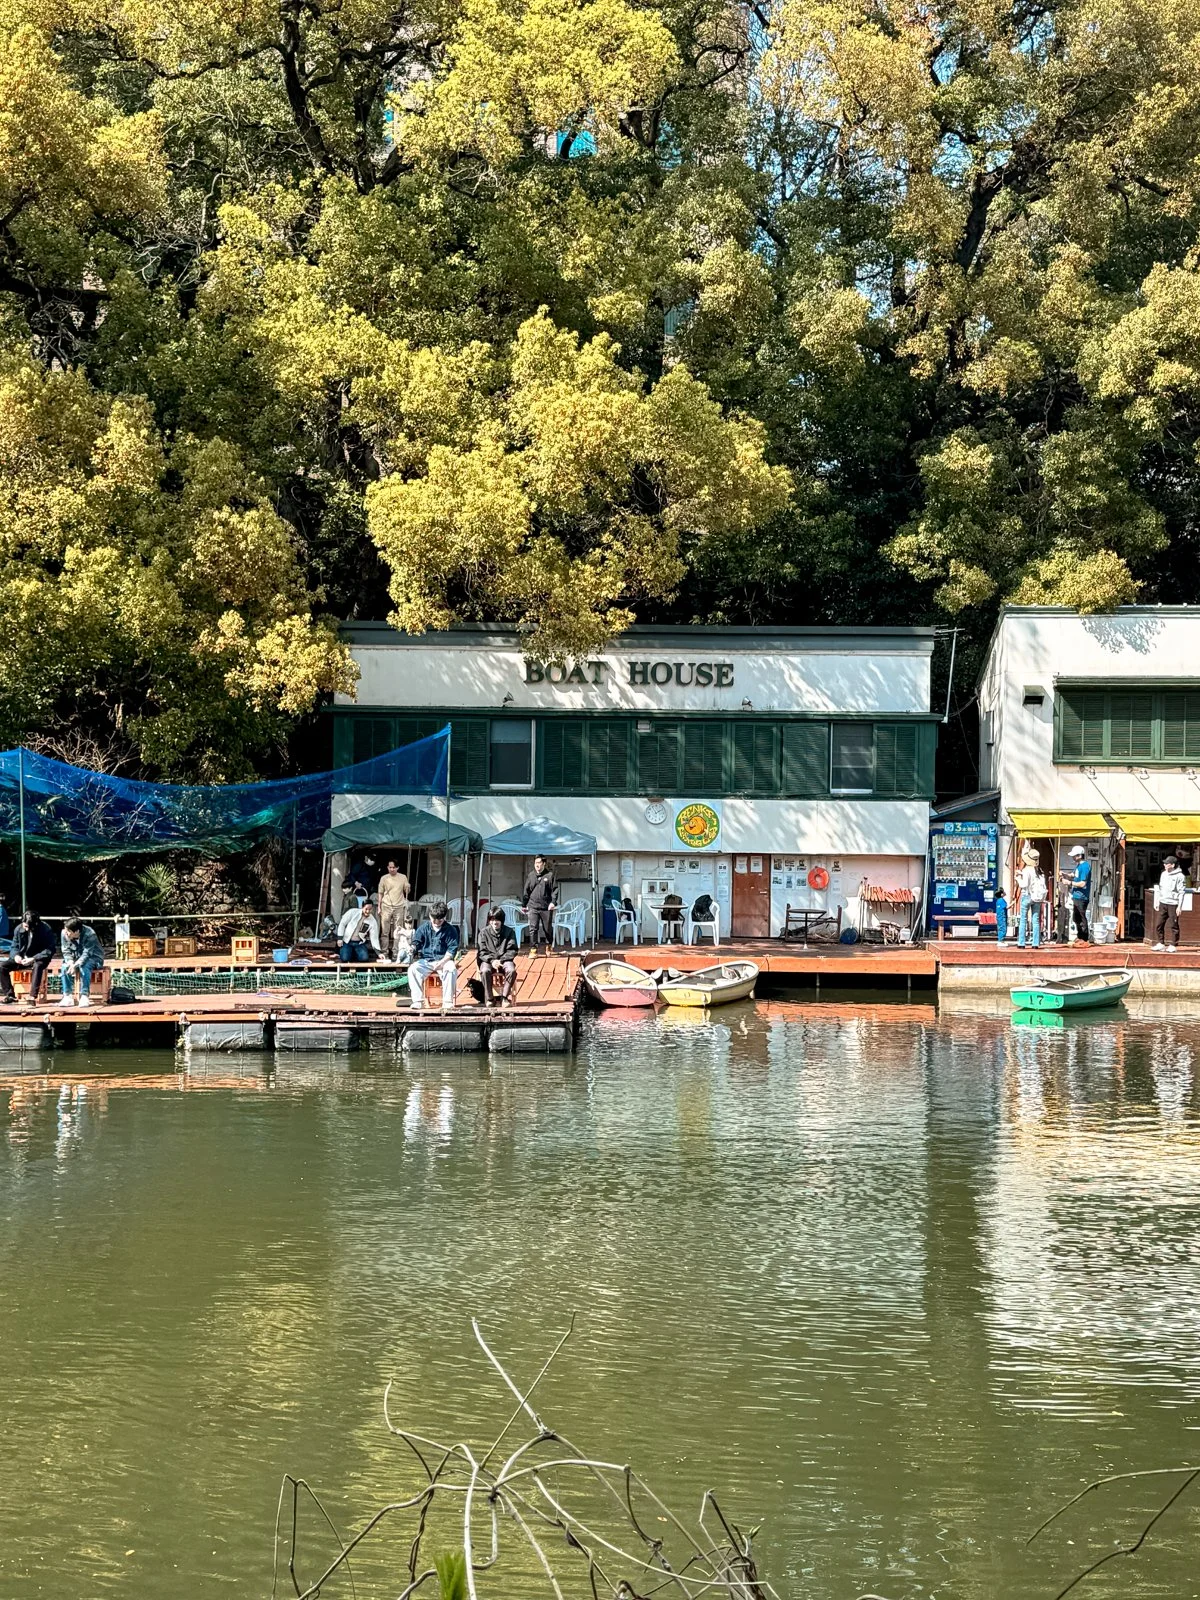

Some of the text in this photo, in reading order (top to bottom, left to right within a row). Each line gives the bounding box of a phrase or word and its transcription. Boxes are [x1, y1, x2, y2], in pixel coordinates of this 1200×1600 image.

[523, 660, 734, 687] BOAT HOUSE
[1029, 994, 1044, 1005] 17
